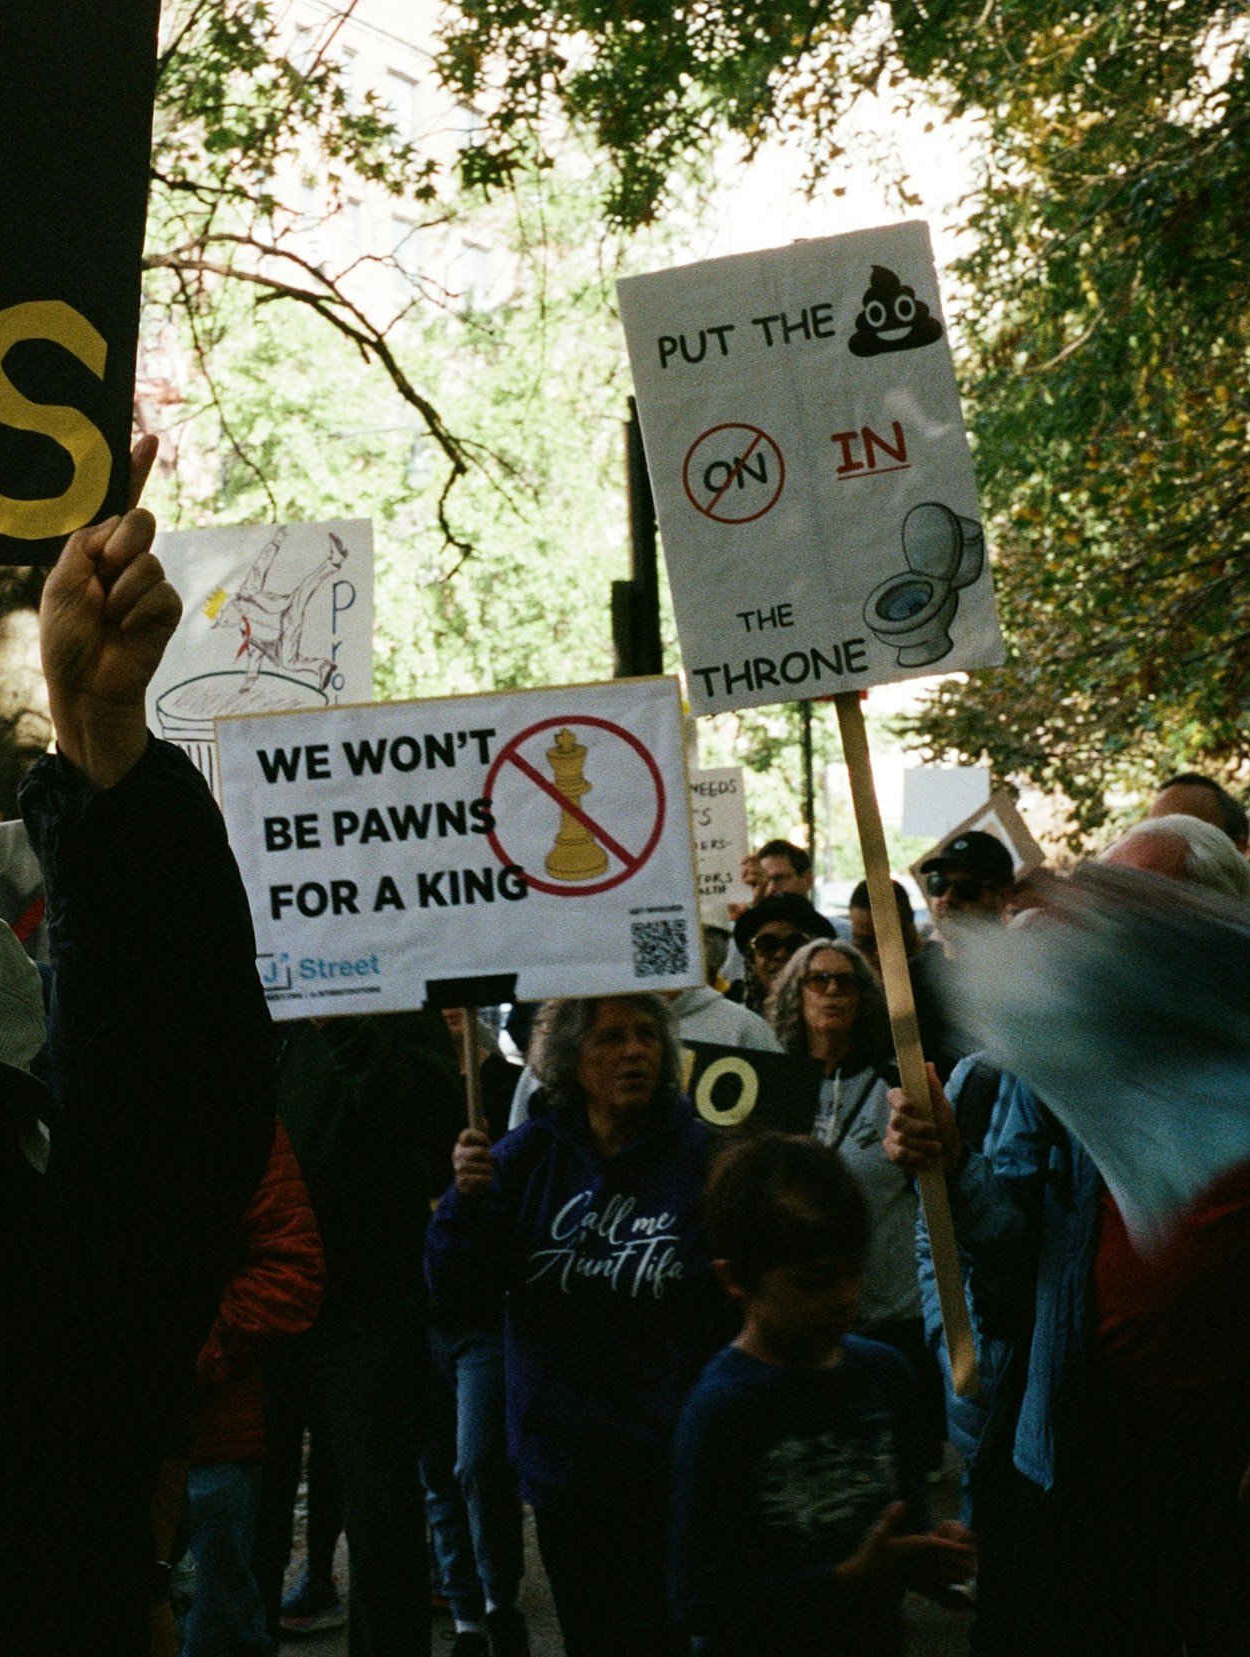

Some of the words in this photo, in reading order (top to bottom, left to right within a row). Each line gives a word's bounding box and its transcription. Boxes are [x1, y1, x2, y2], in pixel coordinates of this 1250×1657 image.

[658, 324, 735, 369] PUT
[753, 302, 837, 348] THE
[703, 453, 768, 495] ON
[831, 420, 909, 475] IN
[736, 603, 795, 633] THE
[692, 637, 870, 698] THRONE
[257, 743, 331, 784] WE
[343, 728, 497, 777] WON'T
[264, 812, 322, 852] BE
[332, 798, 497, 843] PAWNS
[269, 879, 360, 921] FOR
[372, 875, 406, 912] A
[417, 864, 530, 909] KING
[298, 954, 381, 980] Street
[551, 1190, 636, 1245] Call
[630, 1211, 678, 1236] me
[526, 1231, 636, 1294] Aunt
